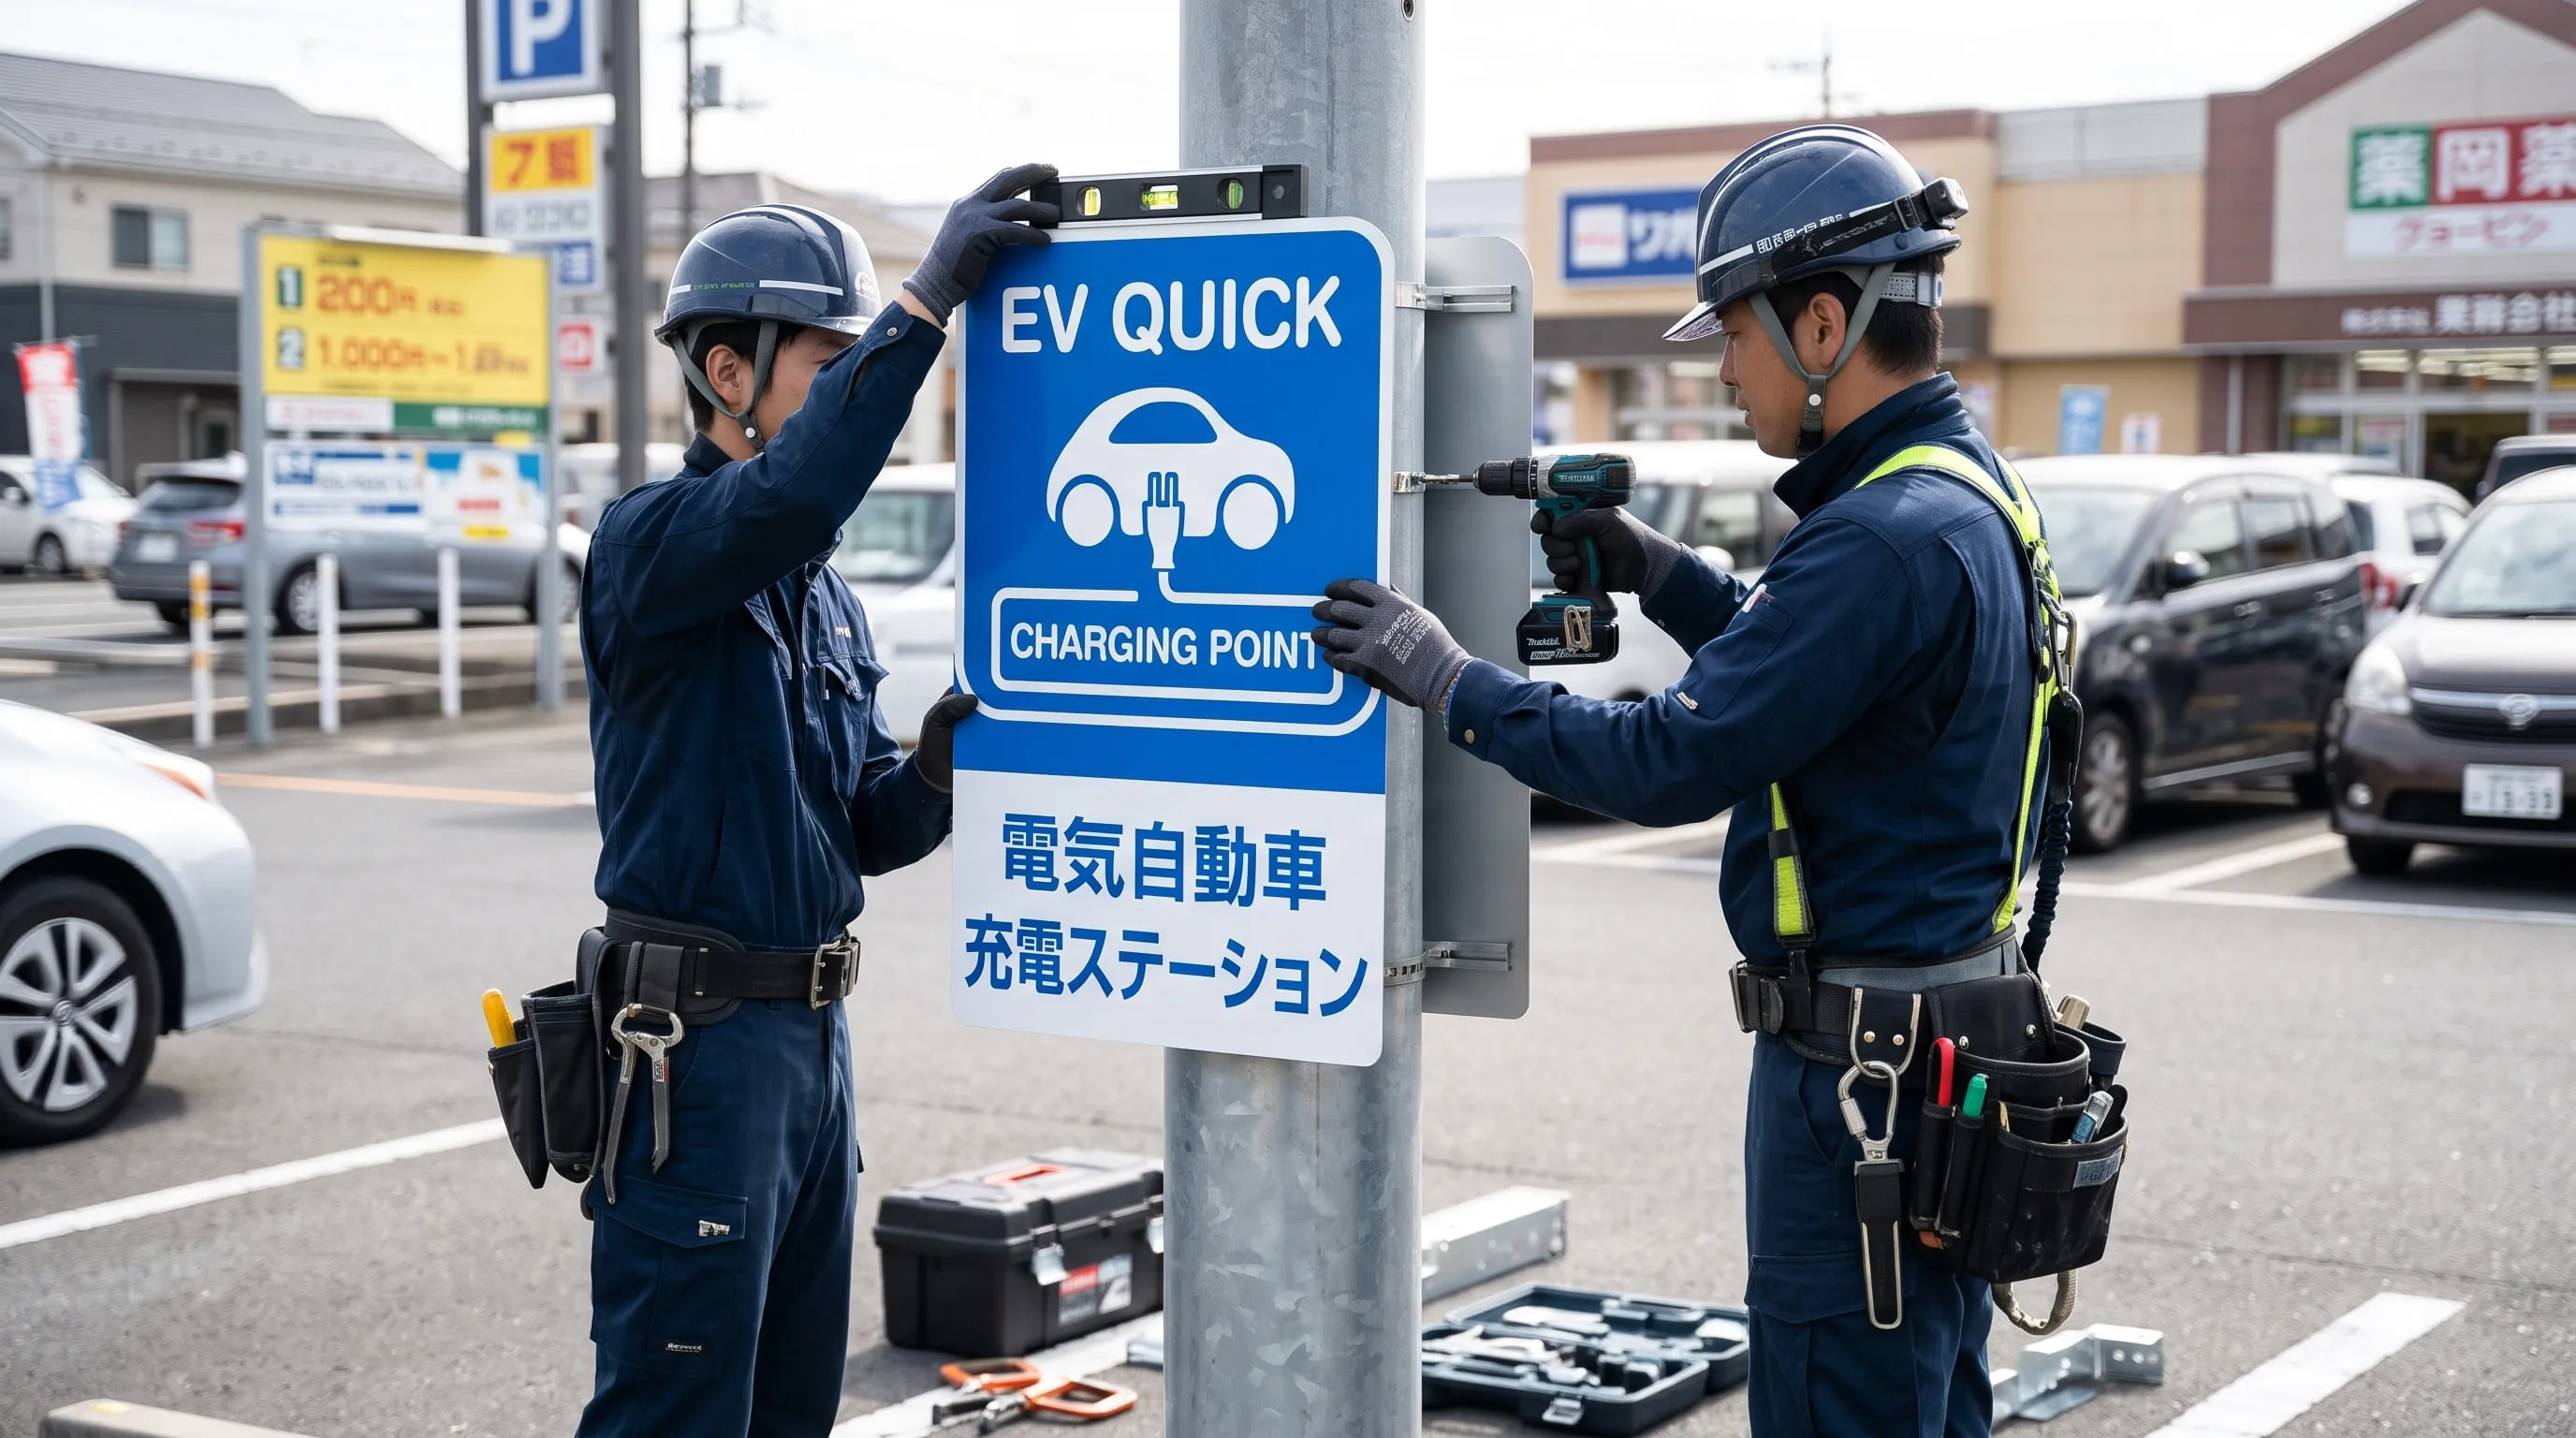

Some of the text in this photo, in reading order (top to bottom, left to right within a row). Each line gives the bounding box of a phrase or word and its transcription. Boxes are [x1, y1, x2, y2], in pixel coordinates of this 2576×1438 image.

[509, 0, 573, 76] P
[1003, 275, 1342, 355] EV QUICK
[1010, 622, 1315, 669] CHARGING POINT
[1003, 813, 1326, 911] 電気自動車
[965, 913, 1368, 1017] 充電ステーション
